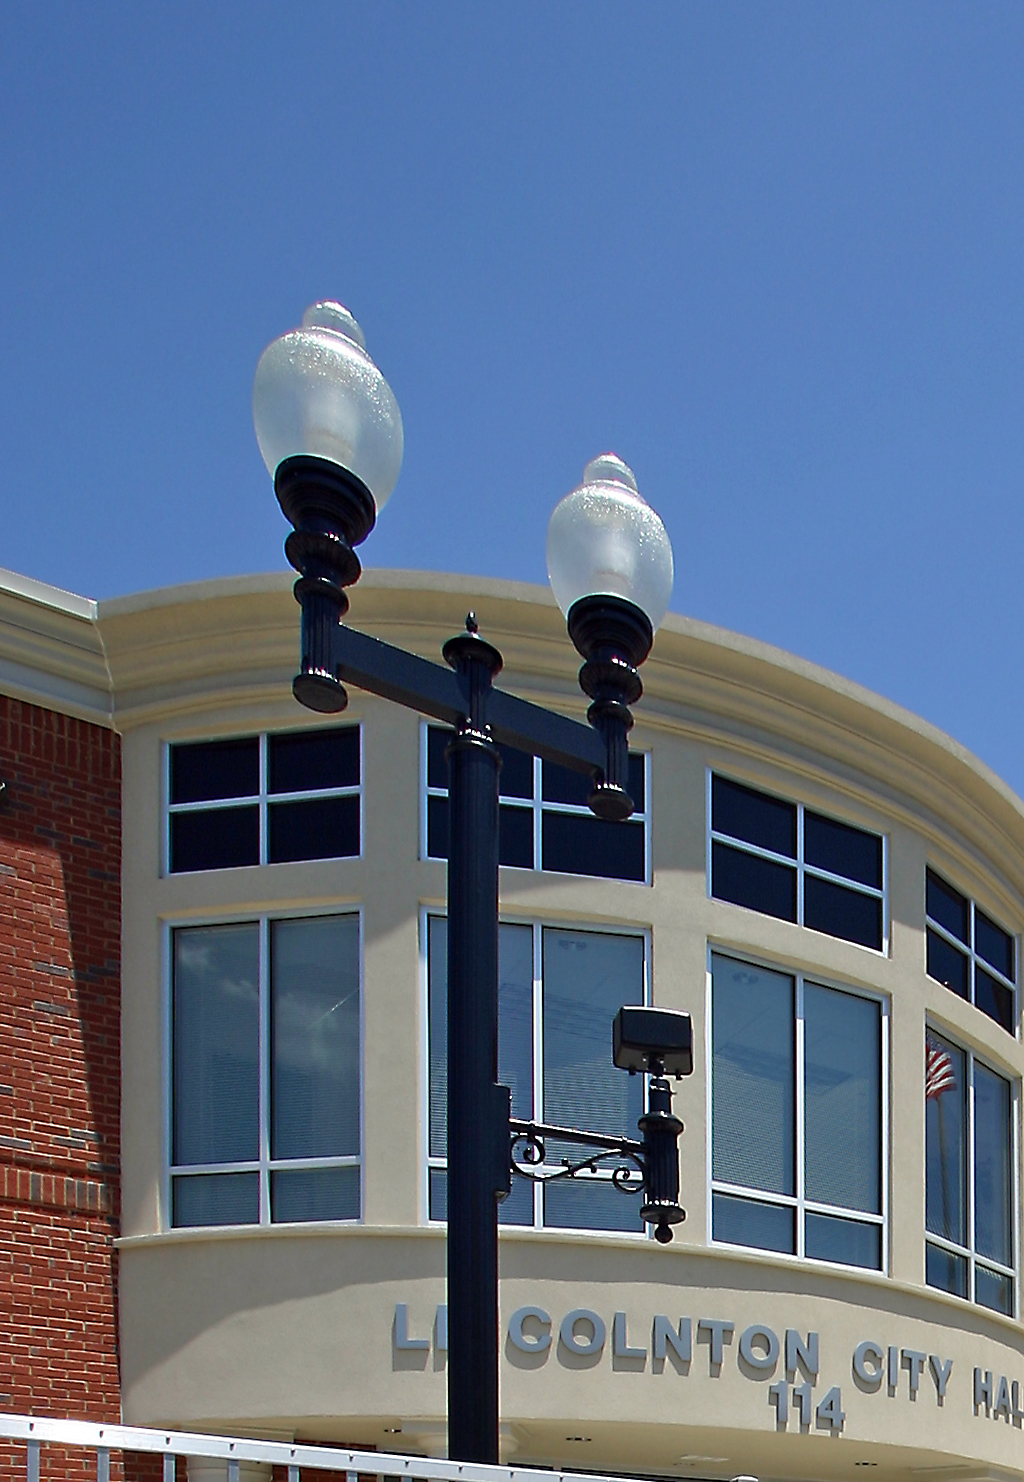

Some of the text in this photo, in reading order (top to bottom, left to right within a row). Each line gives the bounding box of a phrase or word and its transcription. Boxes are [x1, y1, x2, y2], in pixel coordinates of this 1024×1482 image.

[395, 1303, 819, 1374] LICOLNTON
[853, 1341, 953, 1396] CITY
[770, 1379, 845, 1429] 114
